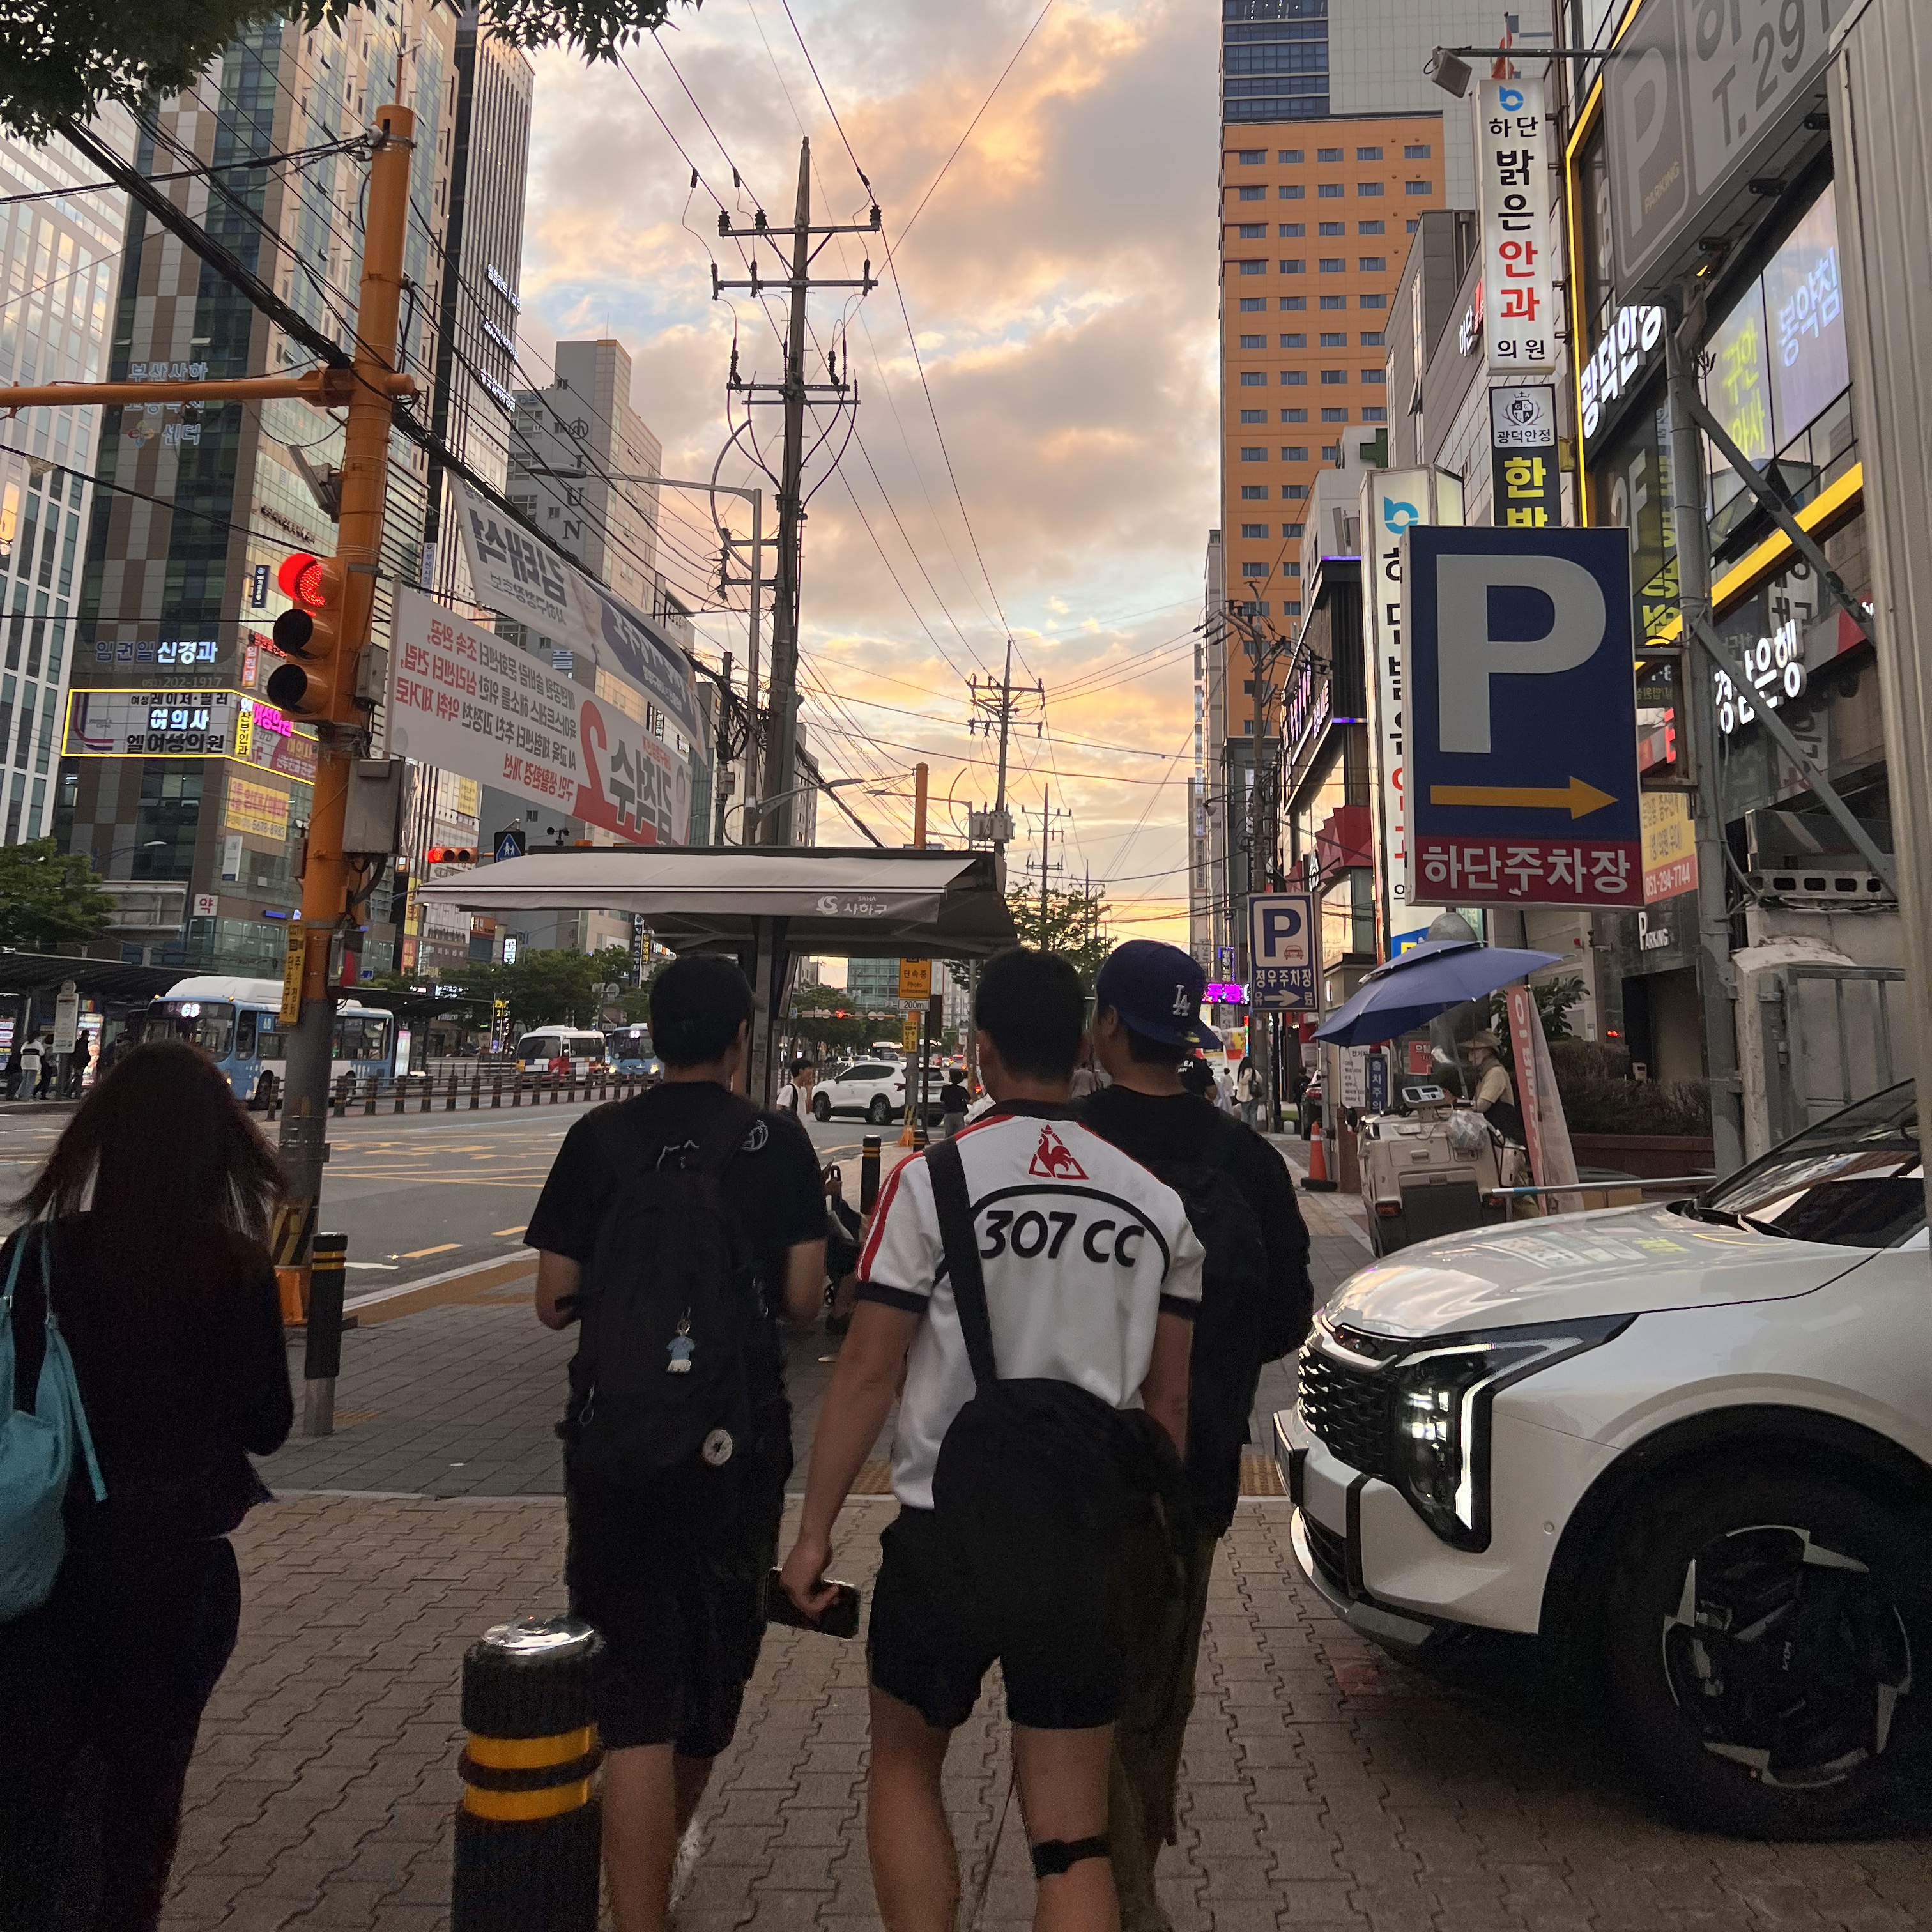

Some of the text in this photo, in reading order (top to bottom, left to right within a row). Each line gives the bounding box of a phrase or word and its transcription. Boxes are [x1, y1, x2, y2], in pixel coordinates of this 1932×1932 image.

[1489, 117, 1539, 138] 하단
[1621, 46, 1669, 238] P
[1644, 160, 1680, 215] PARKING
[1495, 149, 1541, 322] 밝은안과
[1779, 247, 1841, 367] 봉약침
[1497, 339, 1546, 360] 의원
[128, 362, 208, 383] 부산사하
[162, 423, 201, 445] 센터
[1497, 429, 1550, 443] 광덕안정
[1437, 553, 1607, 754] P
[163, 676, 222, 688] 202-1917
[130, 696, 148, 705] 여성
[150, 708, 210, 731] 여의사
[237, 712, 252, 756] 산부인과
[1422, 844, 1631, 897] 하단주차장
[197, 898, 214, 914] 약
[843, 903, 887, 916] 사하구
[1262, 907, 1301, 958] P
[1639, 911, 1669, 951] PARKING
[903, 969, 927, 979] 단속중
[1255, 969, 1312, 990] 정우주차장
[181, 1003, 201, 1018] 68
[903, 1000, 924, 1009] 200m
[1172, 984, 1191, 1017] LA
[980, 1210, 1145, 1268] 307 CC
